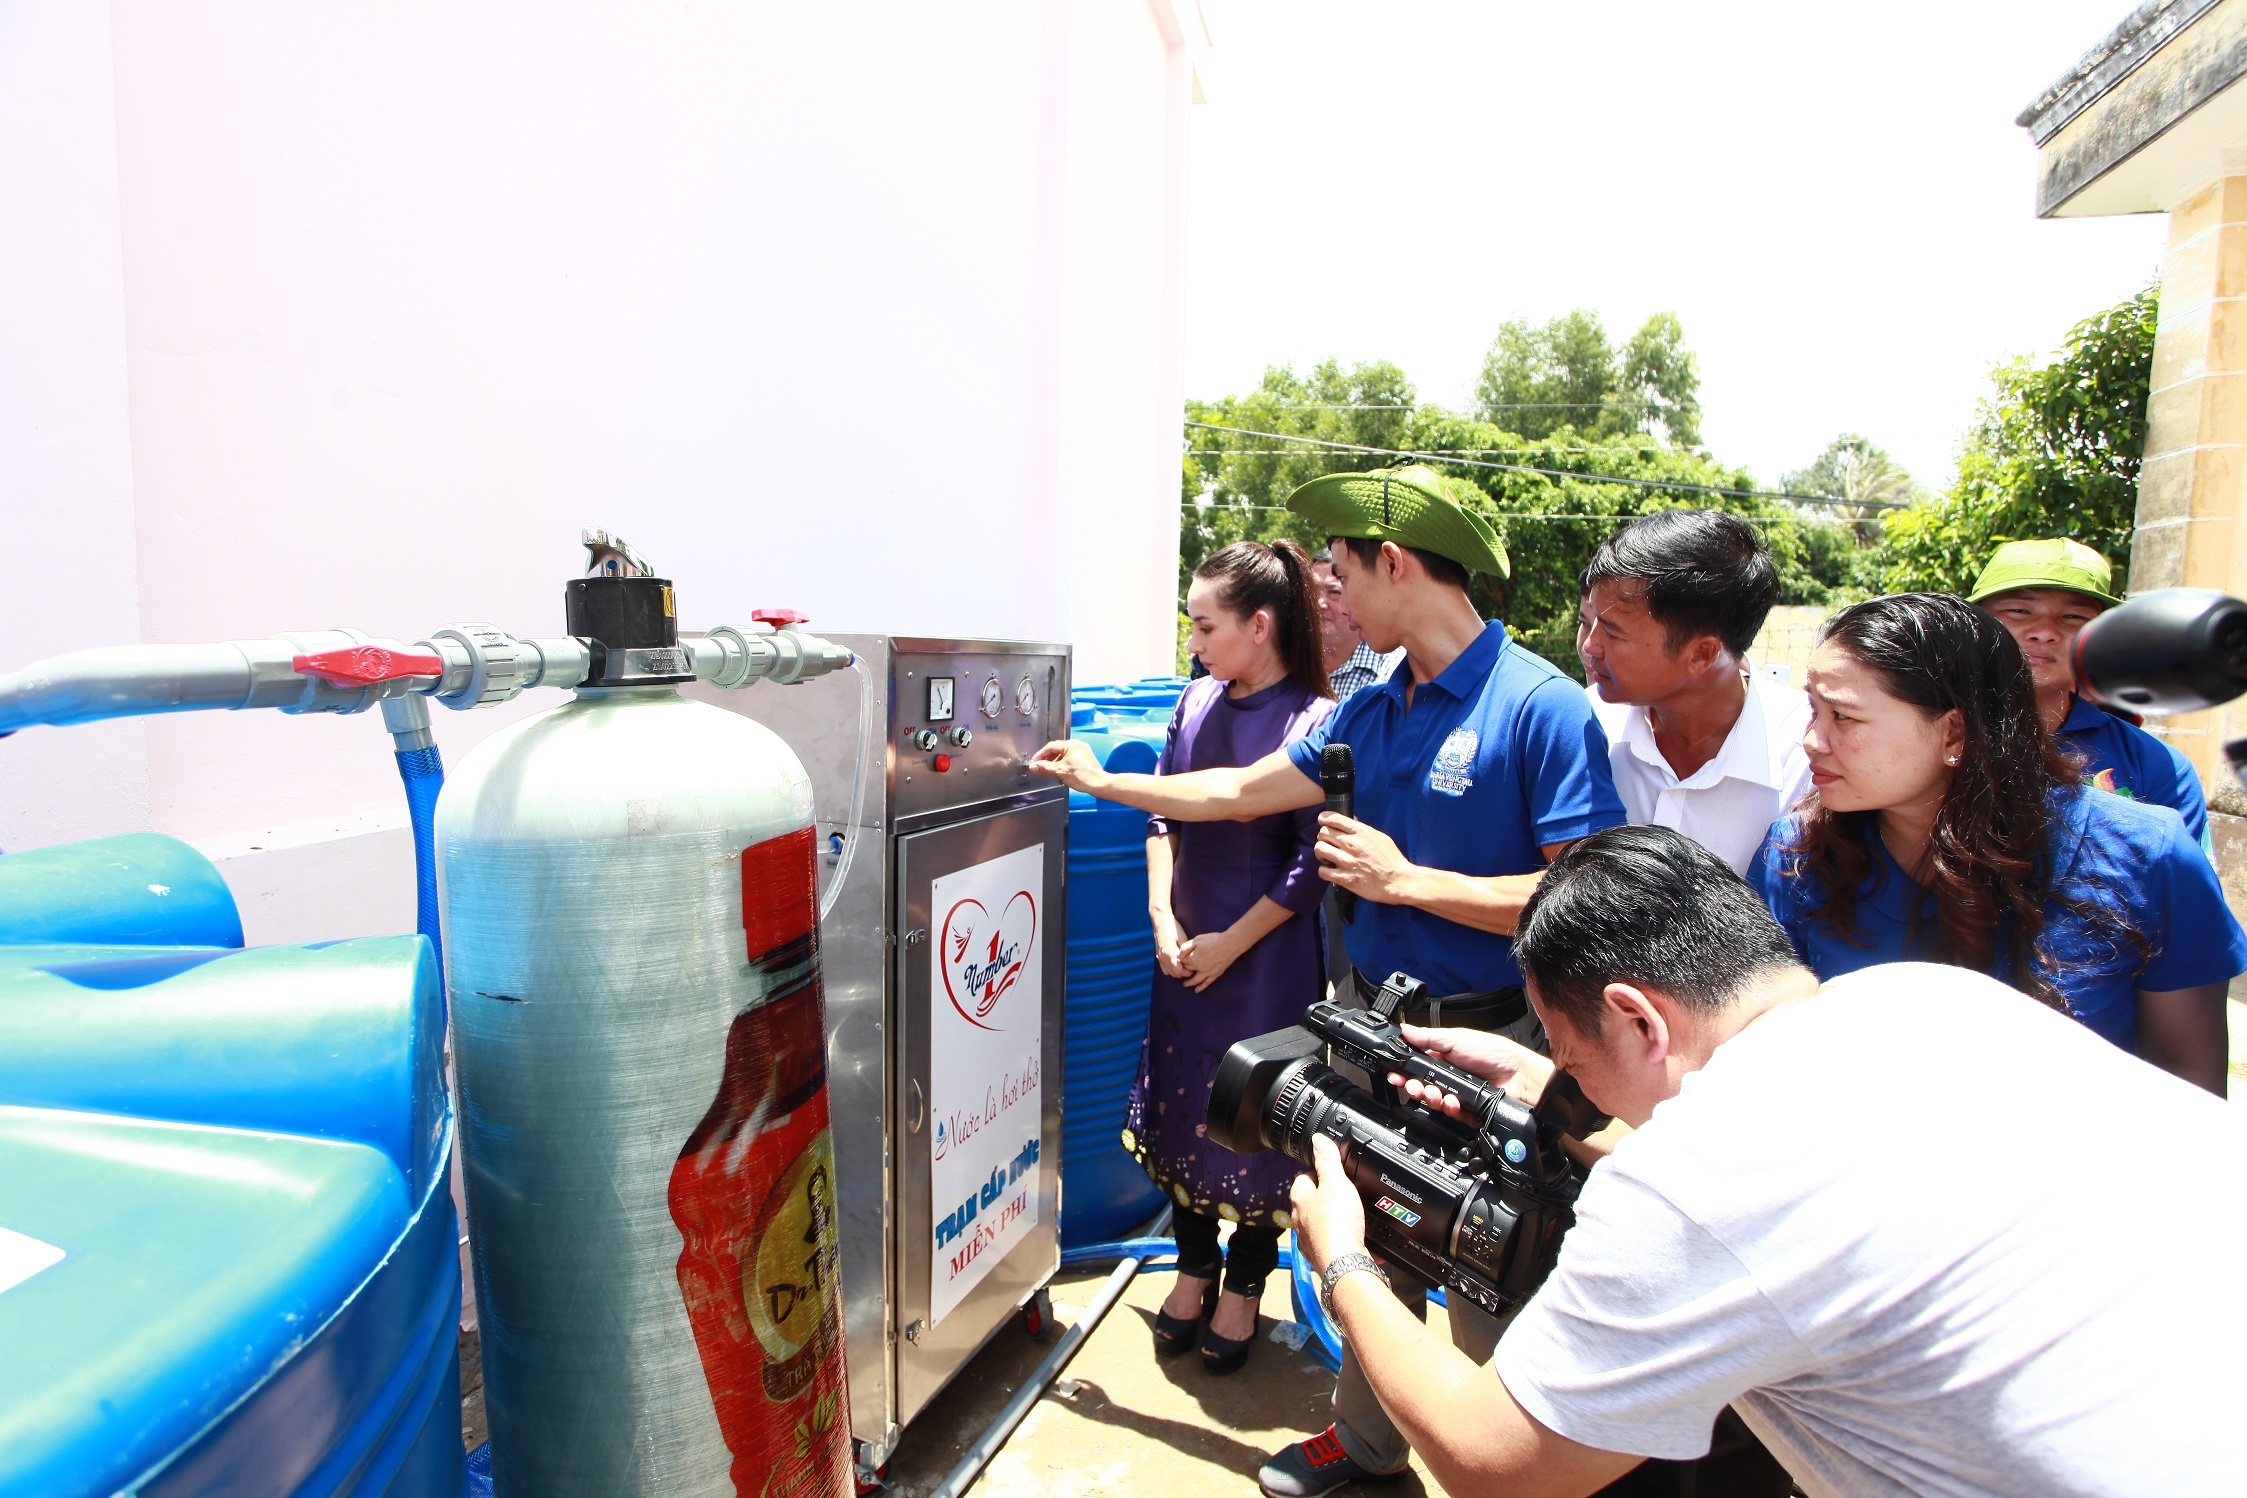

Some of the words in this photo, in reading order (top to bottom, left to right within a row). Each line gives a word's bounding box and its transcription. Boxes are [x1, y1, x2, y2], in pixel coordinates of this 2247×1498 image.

[904, 727, 916, 736] OFF
[964, 939, 1018, 997] Number
[935, 1109, 980, 1161] Nước
[984, 1086, 997, 1125] là
[1002, 1073, 1018, 1112] hơi
[1022, 1056, 1039, 1096] thở
[936, 1193, 977, 1250] TRẠM
[981, 1165, 1006, 1210] CẤP
[1009, 1139, 1039, 1186] NƯỚC
[1376, 1197, 1420, 1225] HTV
[1380, 1173, 1423, 1205] Panasonic
[950, 1222, 996, 1281] MIỄN
[1000, 1184, 1028, 1232] PHÍ
